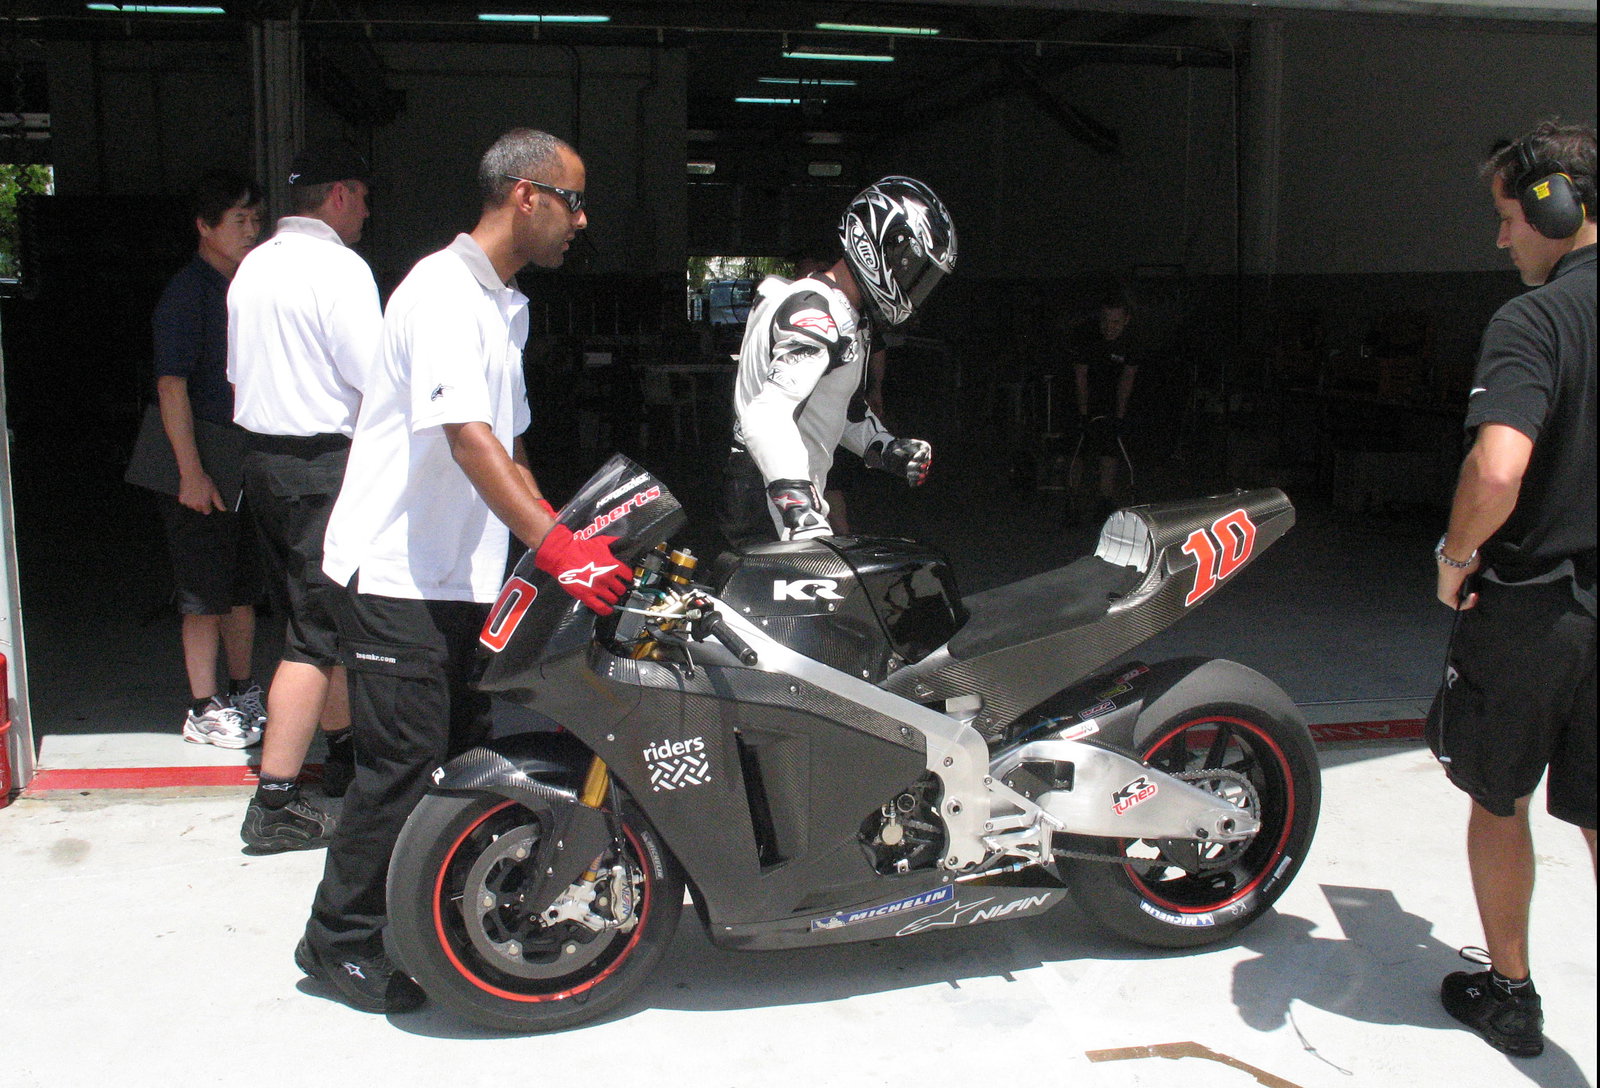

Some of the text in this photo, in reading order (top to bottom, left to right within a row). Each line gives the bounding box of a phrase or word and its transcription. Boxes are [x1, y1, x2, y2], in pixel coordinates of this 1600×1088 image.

[1181, 508, 1256, 607] 10
[773, 579, 845, 601] KR
[643, 736, 705, 762] riders
[848, 890, 948, 923] MICHELIN
